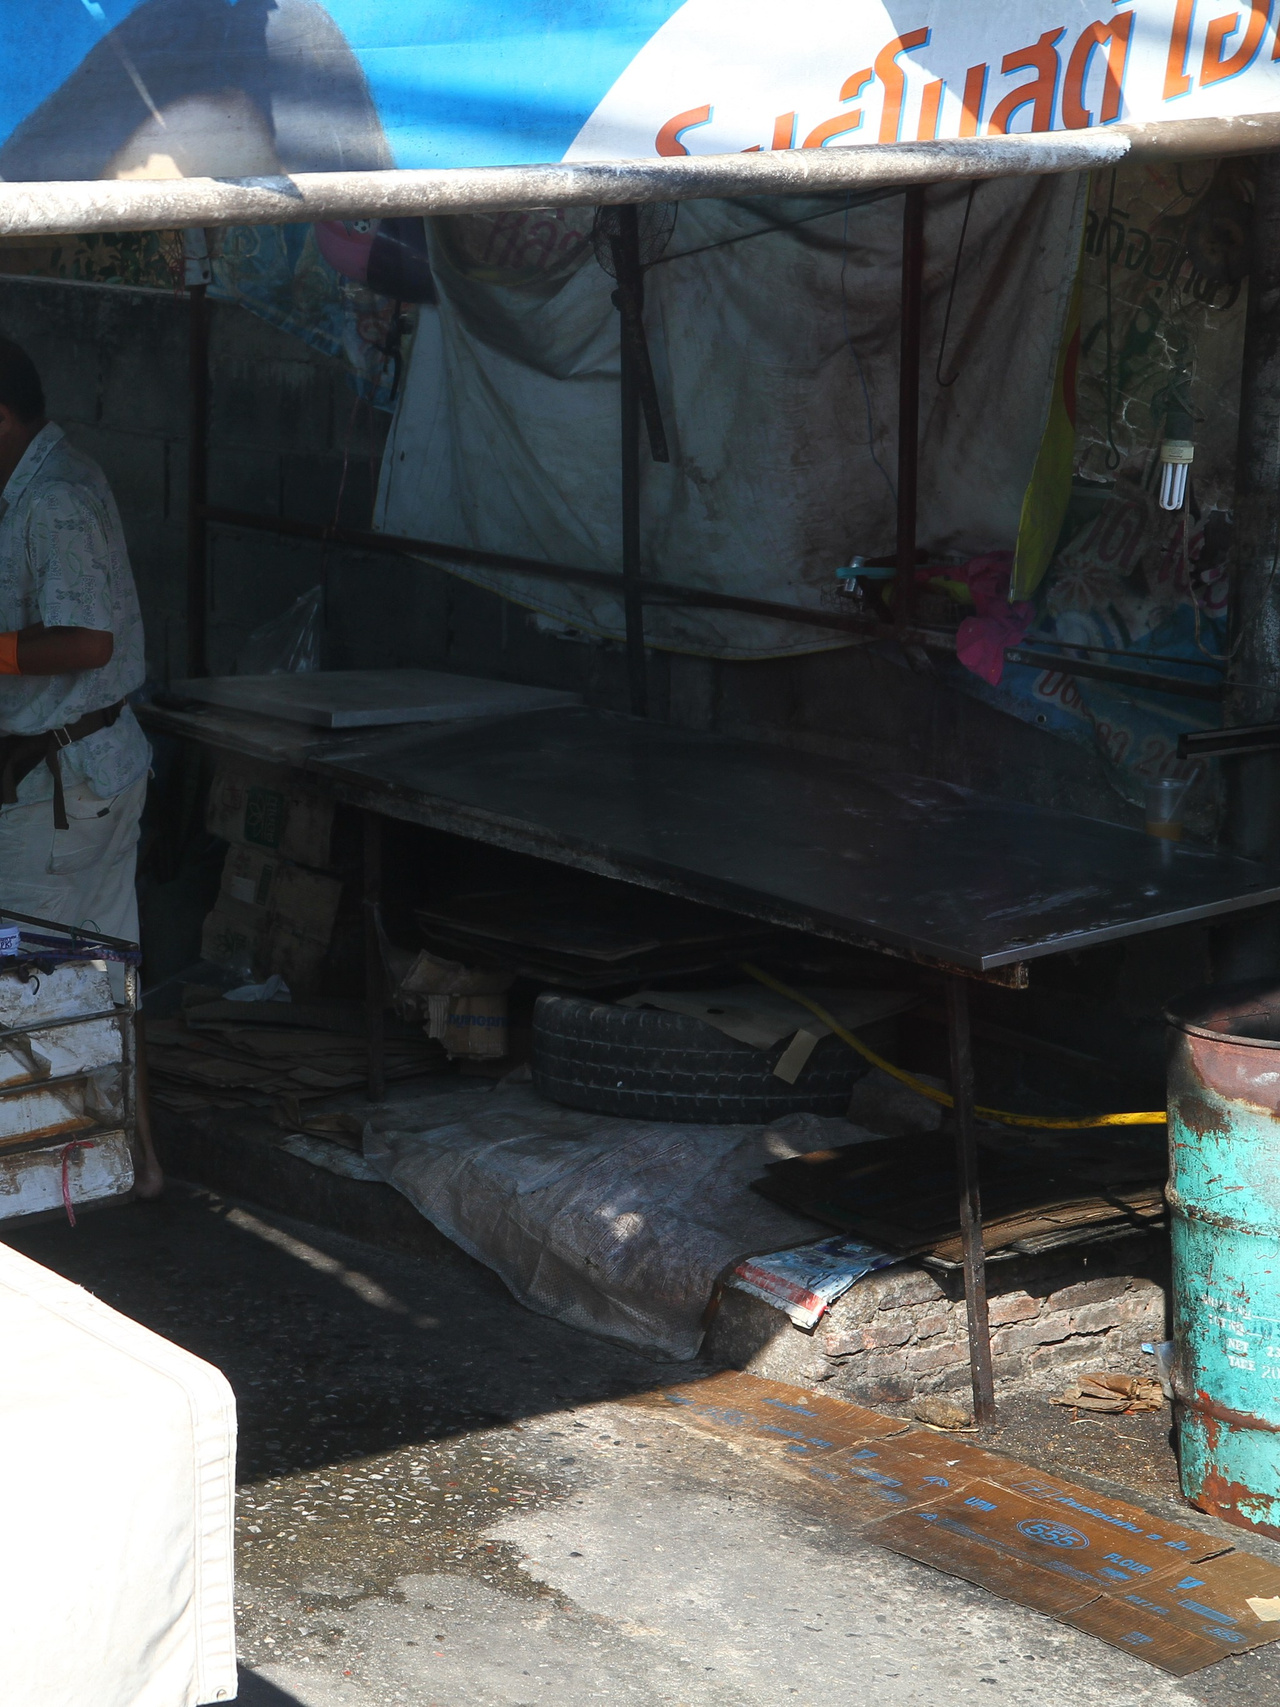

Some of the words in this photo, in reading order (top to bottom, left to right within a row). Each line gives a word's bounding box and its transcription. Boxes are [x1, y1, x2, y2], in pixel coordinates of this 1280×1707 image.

[964, 1495, 998, 1513] UFM
[1025, 1522, 1081, 1548] 555
[1102, 1552, 1153, 1575] FLOUR
